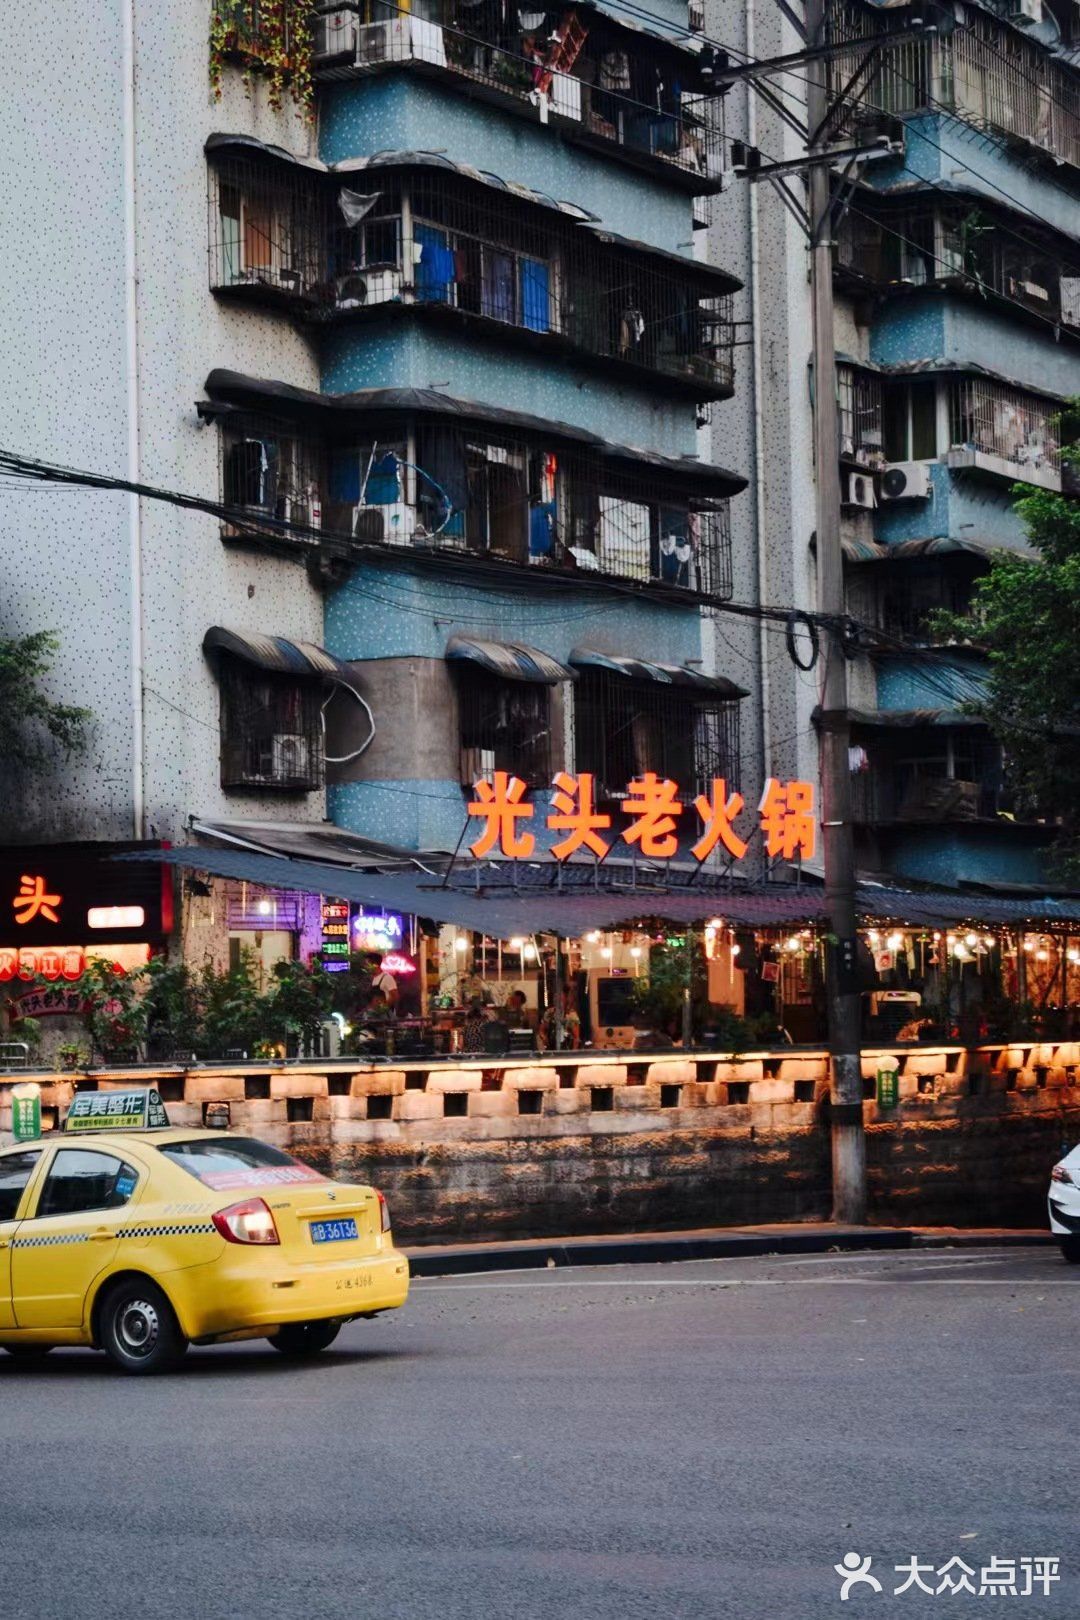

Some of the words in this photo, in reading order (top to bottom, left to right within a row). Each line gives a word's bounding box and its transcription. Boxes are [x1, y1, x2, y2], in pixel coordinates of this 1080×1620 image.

[468, 771, 816, 861] 光头老火锅
[13, 875, 62, 924] 头
